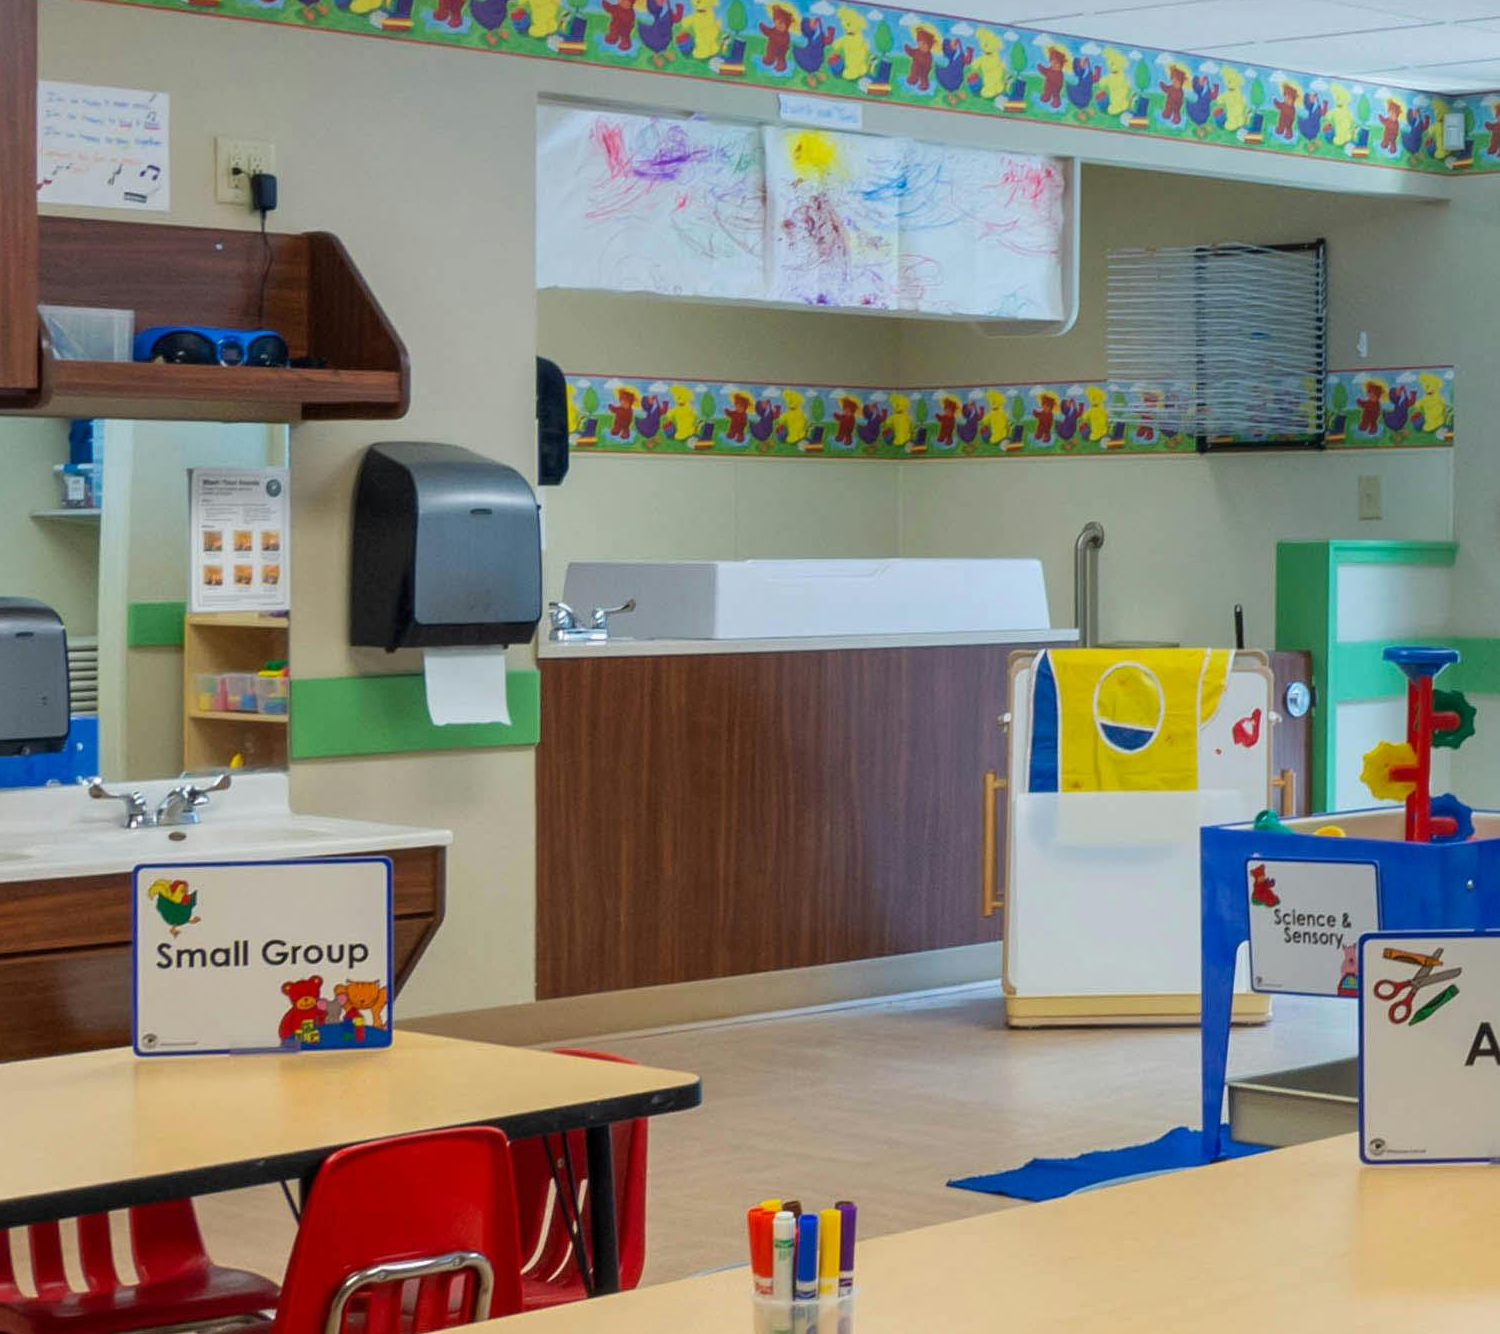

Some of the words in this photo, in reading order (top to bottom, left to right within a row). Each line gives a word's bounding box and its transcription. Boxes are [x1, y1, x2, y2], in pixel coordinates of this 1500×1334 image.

[1274, 908, 1336, 928] Science
[1341, 912, 1352, 928] &
[1283, 927, 1344, 949] Sensory
[156, 940, 248, 969] Small
[261, 939, 369, 968] Group
